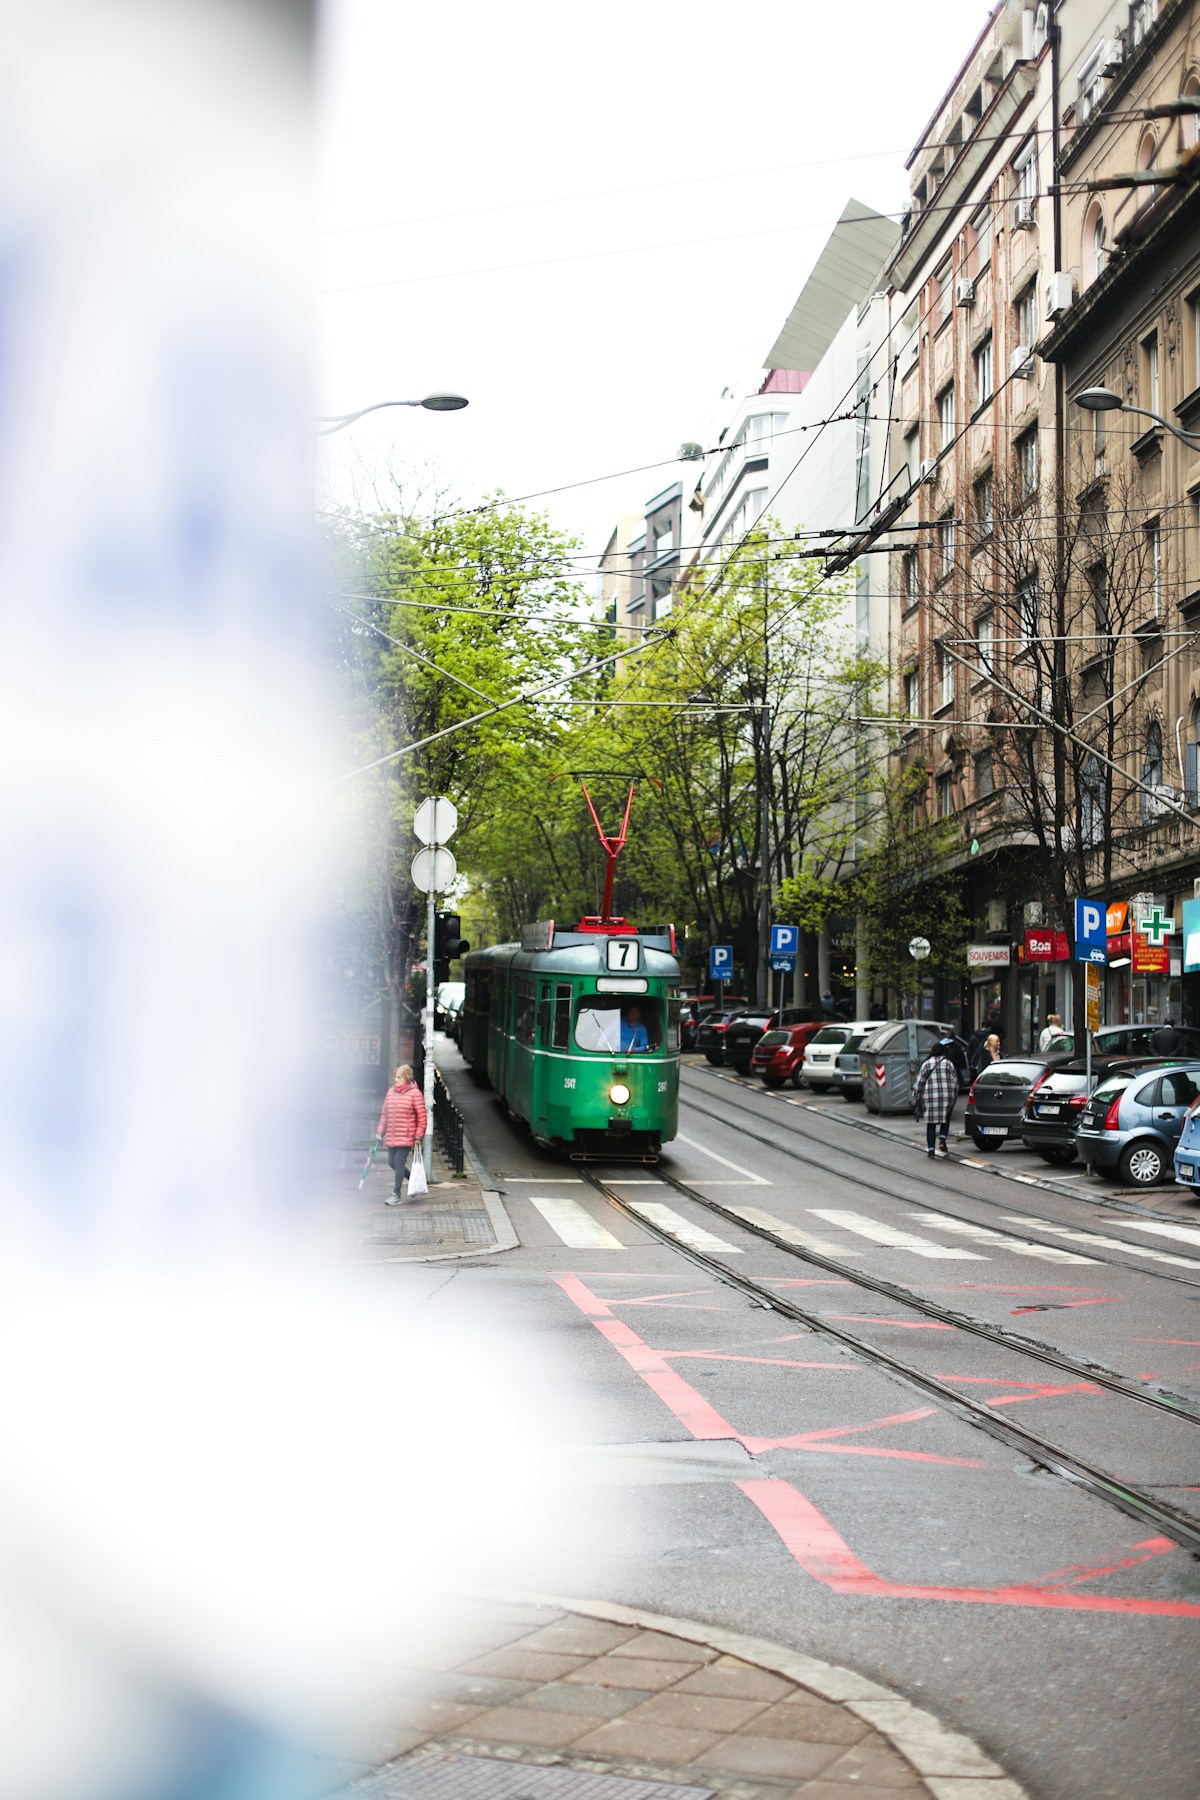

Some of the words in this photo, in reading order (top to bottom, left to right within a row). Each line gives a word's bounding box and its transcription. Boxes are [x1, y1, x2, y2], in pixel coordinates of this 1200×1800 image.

[1083, 906, 1100, 938] P
[777, 929, 793, 949] P
[619, 944, 630, 967] 7
[714, 948, 728, 966] P
[969, 951, 1009, 961] SOUVENIRS
